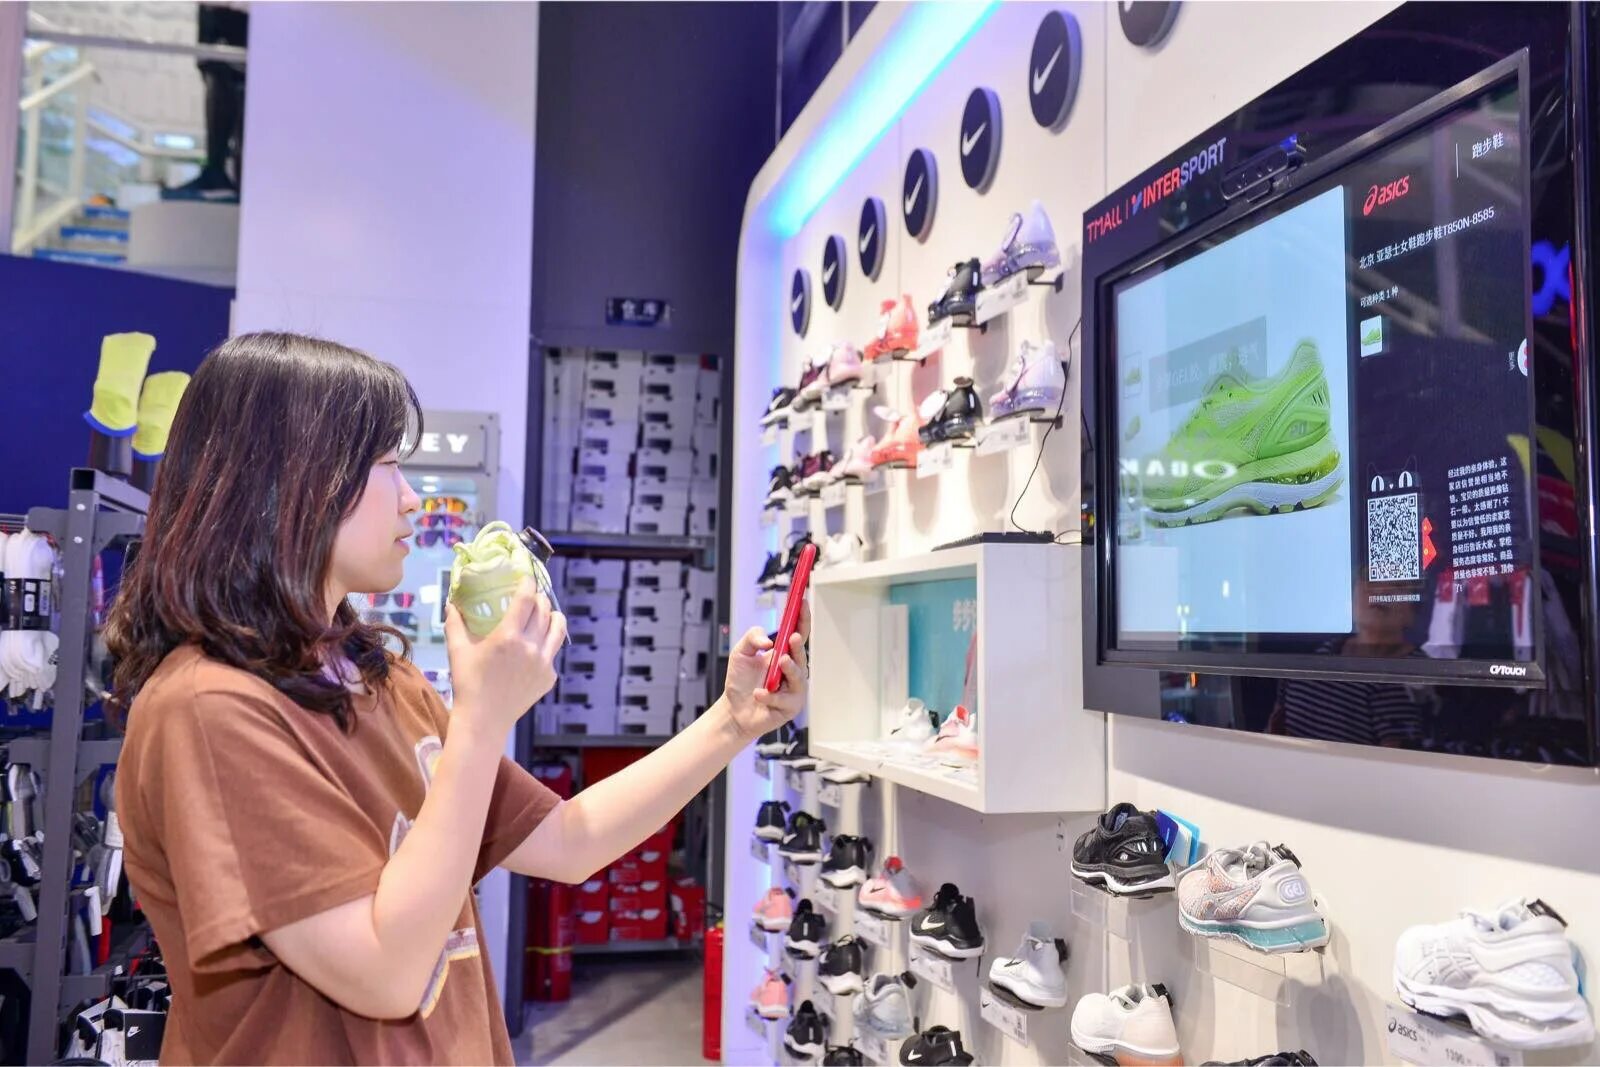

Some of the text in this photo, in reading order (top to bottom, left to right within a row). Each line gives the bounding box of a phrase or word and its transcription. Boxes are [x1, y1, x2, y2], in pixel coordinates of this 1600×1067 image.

[1472, 132, 1504, 159] 跑步鞋
[1087, 137, 1226, 243] TMALL INTERSPORT
[1378, 175, 1409, 205] asics
[1360, 253, 1374, 269] 北京
[1284, 881, 1305, 898] GEL
[1397, 1023, 1418, 1041] asics
